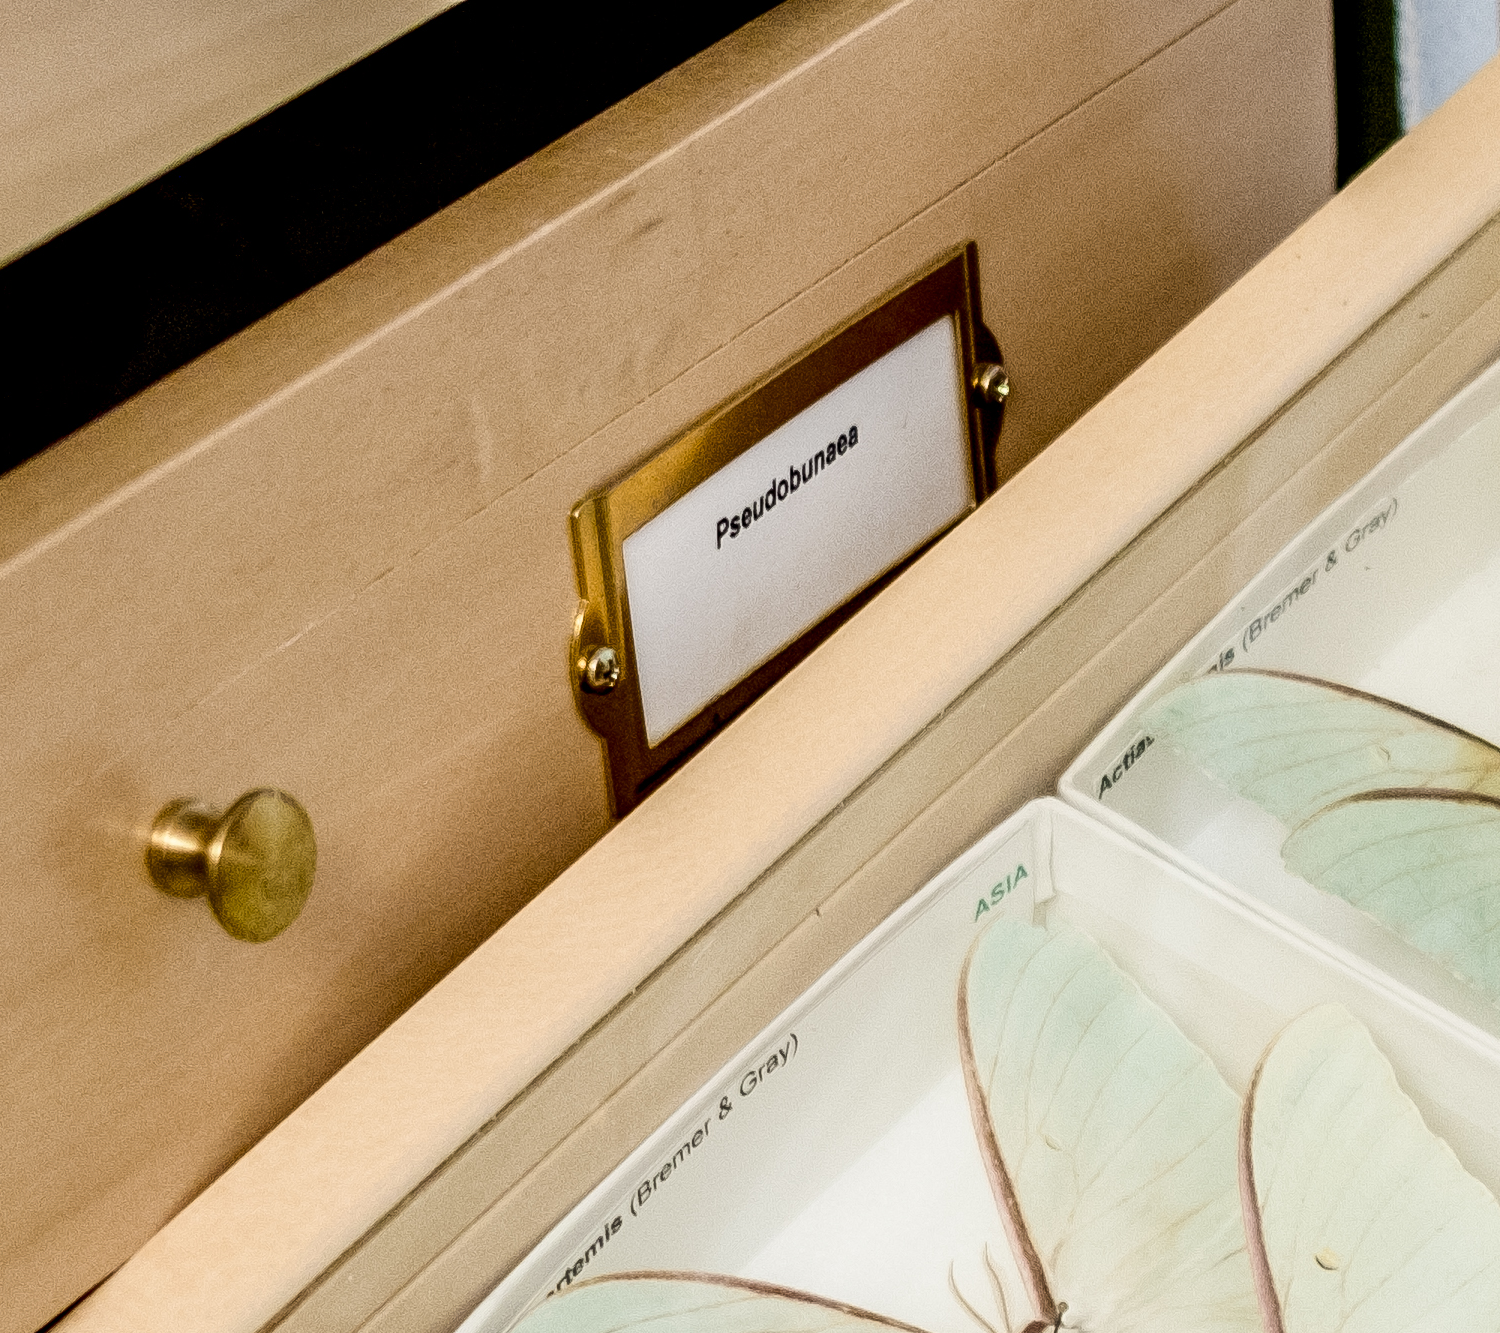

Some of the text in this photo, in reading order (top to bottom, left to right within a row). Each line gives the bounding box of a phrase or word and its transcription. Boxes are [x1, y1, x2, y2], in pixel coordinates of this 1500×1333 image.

[715, 424, 859, 549] Pseudobunaea
[1099, 497, 1398, 798] Actia (Bremer & Gray)
[972, 864, 1028, 922] ASIA
[629, 1116, 711, 1218] (Bremer
[717, 1096, 733, 1120] &
[739, 1032, 799, 1098] Gray)
